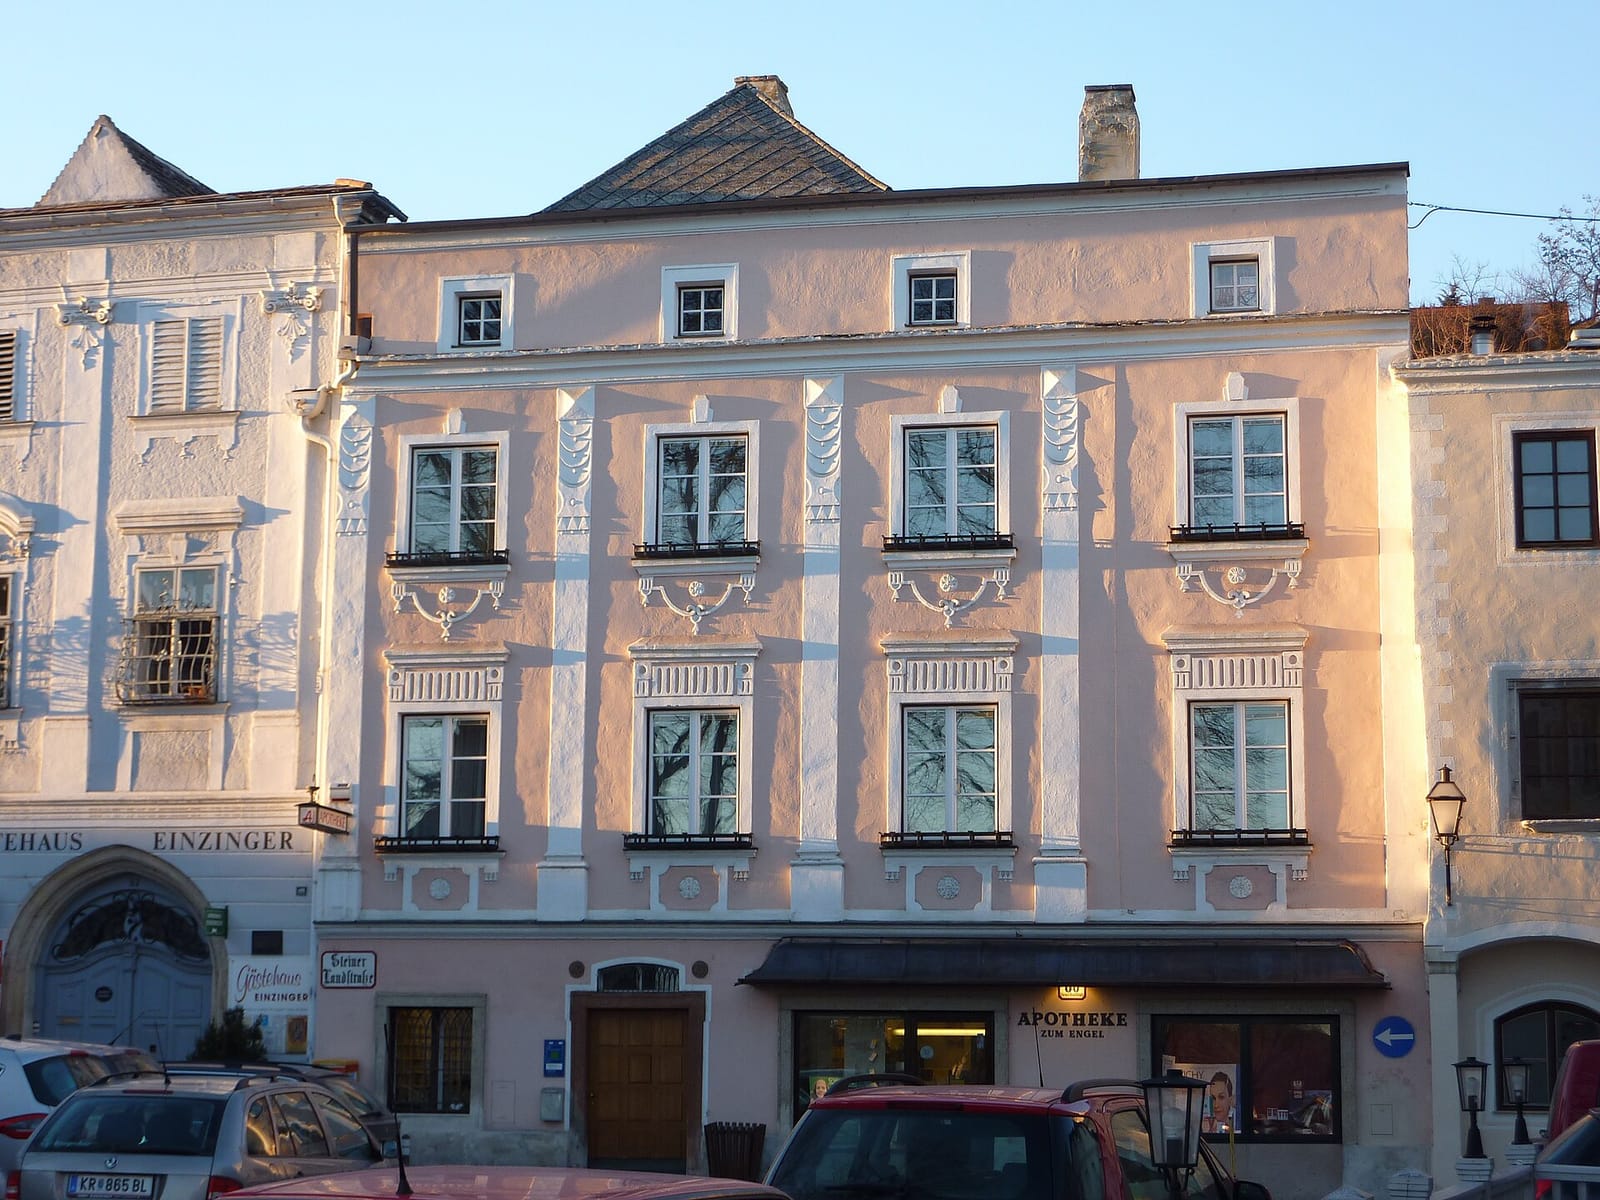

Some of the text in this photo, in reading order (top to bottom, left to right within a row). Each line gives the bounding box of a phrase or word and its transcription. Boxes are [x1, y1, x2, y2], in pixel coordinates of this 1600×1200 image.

[0, 831, 293, 851] EHAUS EINZINGER
[331, 953, 367, 968] Steiner
[237, 964, 301, 1003] Gästehaus
[254, 993, 309, 1002] EINZINGER
[1018, 1012, 1128, 1026] APOTHEKE
[1041, 1030, 1104, 1038] ZUM ENGEL
[80, 1177, 147, 1193] KR 865 BL
